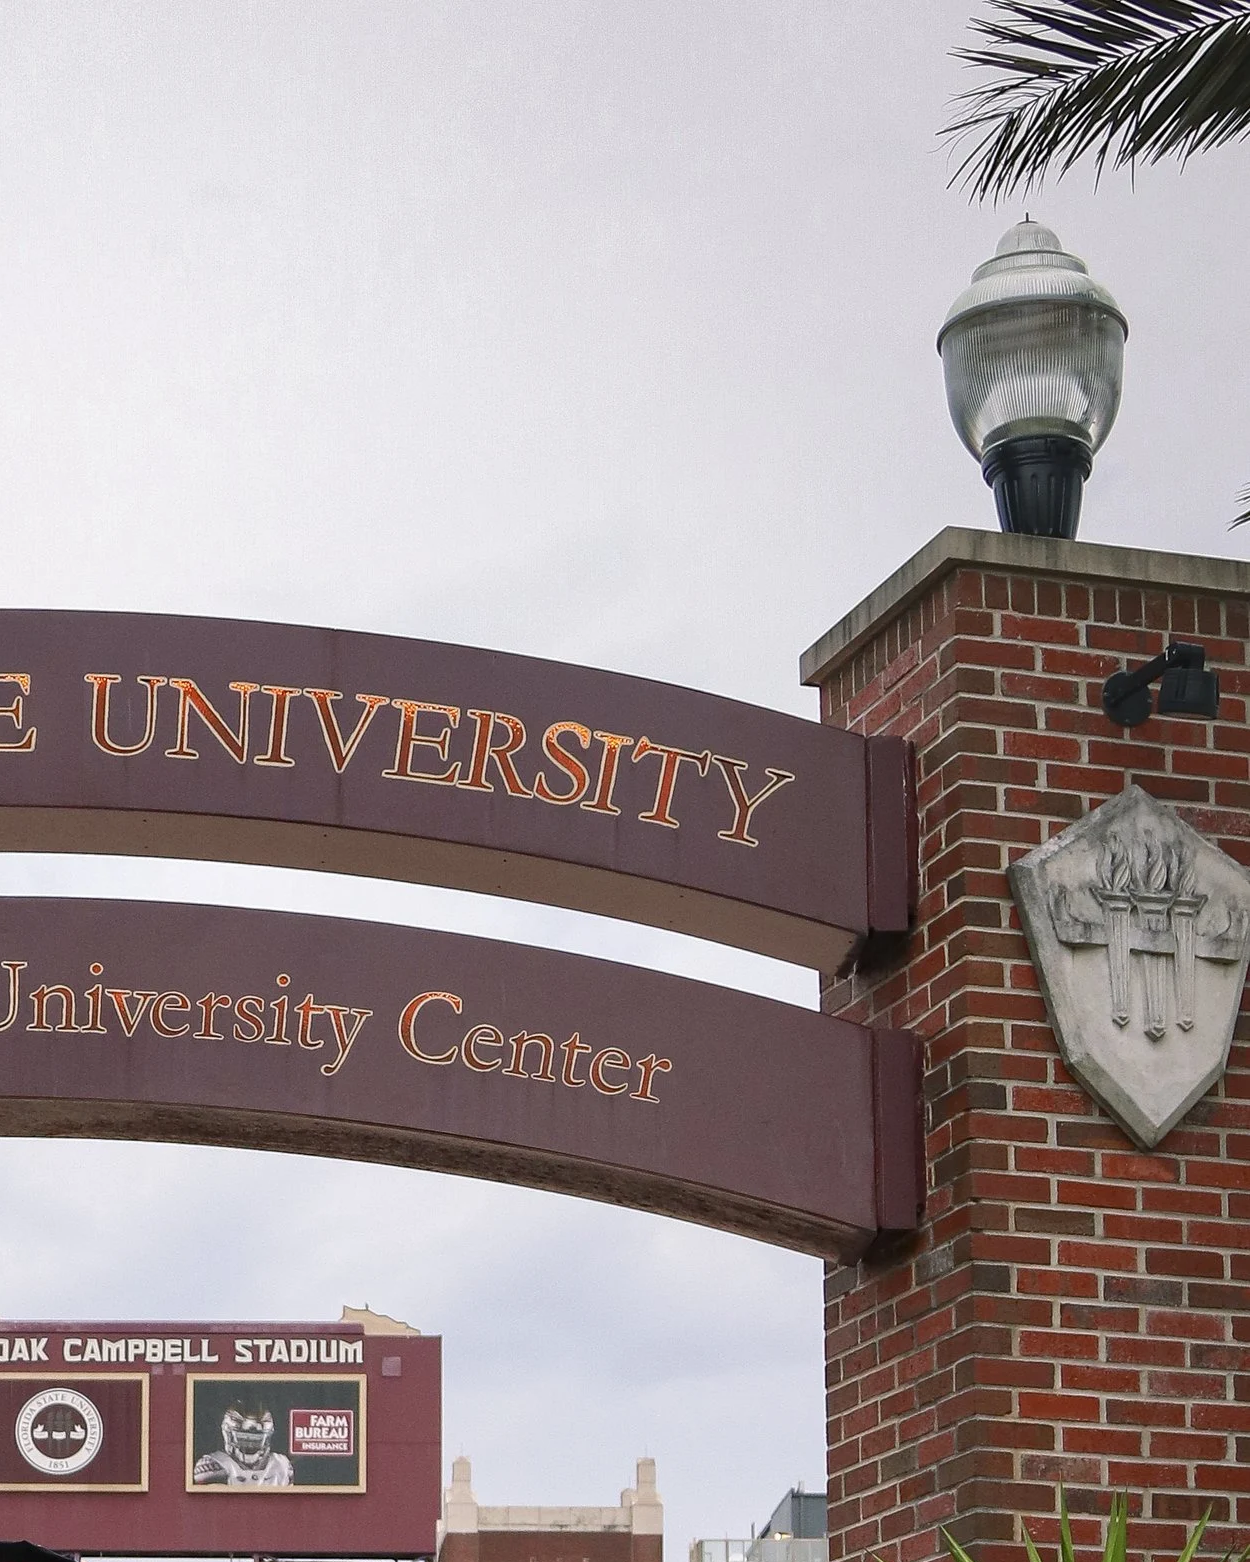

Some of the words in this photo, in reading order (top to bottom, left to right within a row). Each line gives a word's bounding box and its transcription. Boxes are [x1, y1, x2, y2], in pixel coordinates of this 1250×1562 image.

[85, 674, 795, 848] UNIVERSITY
[399, 991, 673, 1104] Center
[63, 1338, 218, 1363] CAMPBELL
[234, 1338, 364, 1363] STADIUM
[21, 1407, 36, 1453] FLORIDA
[36, 1393, 67, 1407] STATE
[71, 1396, 98, 1454] UNIVERSITY
[310, 1415, 348, 1427] FARM
[295, 1427, 349, 1439] BUREAU
[302, 1442, 348, 1451] INSURANCE
[48, 1460, 69, 1469] 1851
